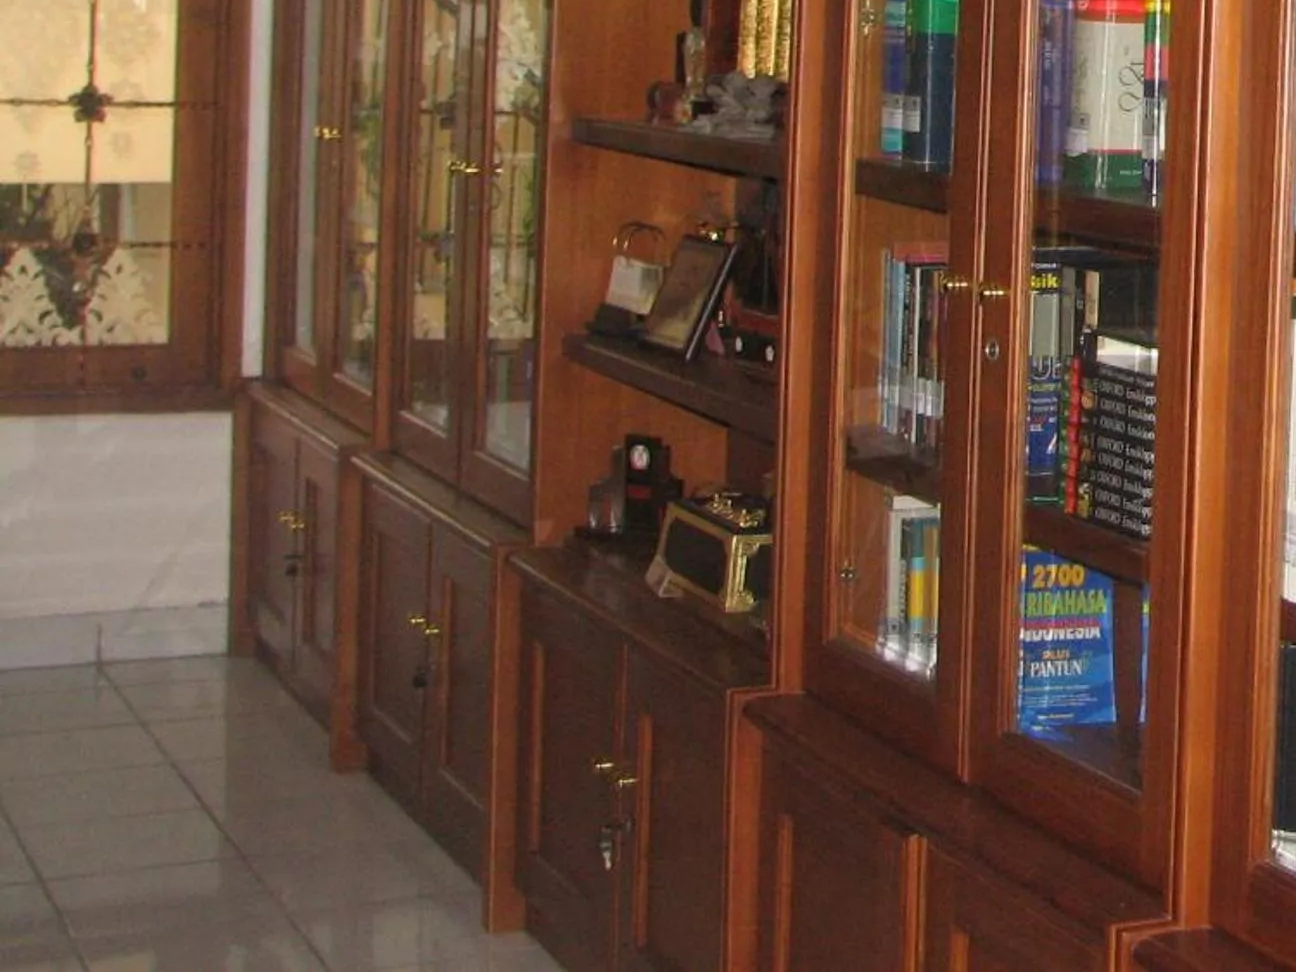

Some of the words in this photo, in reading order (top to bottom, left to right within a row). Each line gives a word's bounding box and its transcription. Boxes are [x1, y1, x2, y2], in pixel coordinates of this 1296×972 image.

[1033, 563, 1086, 588] 2700
[1026, 590, 1107, 617] RIBAHASA
[1031, 660, 1083, 678] PANTUN
